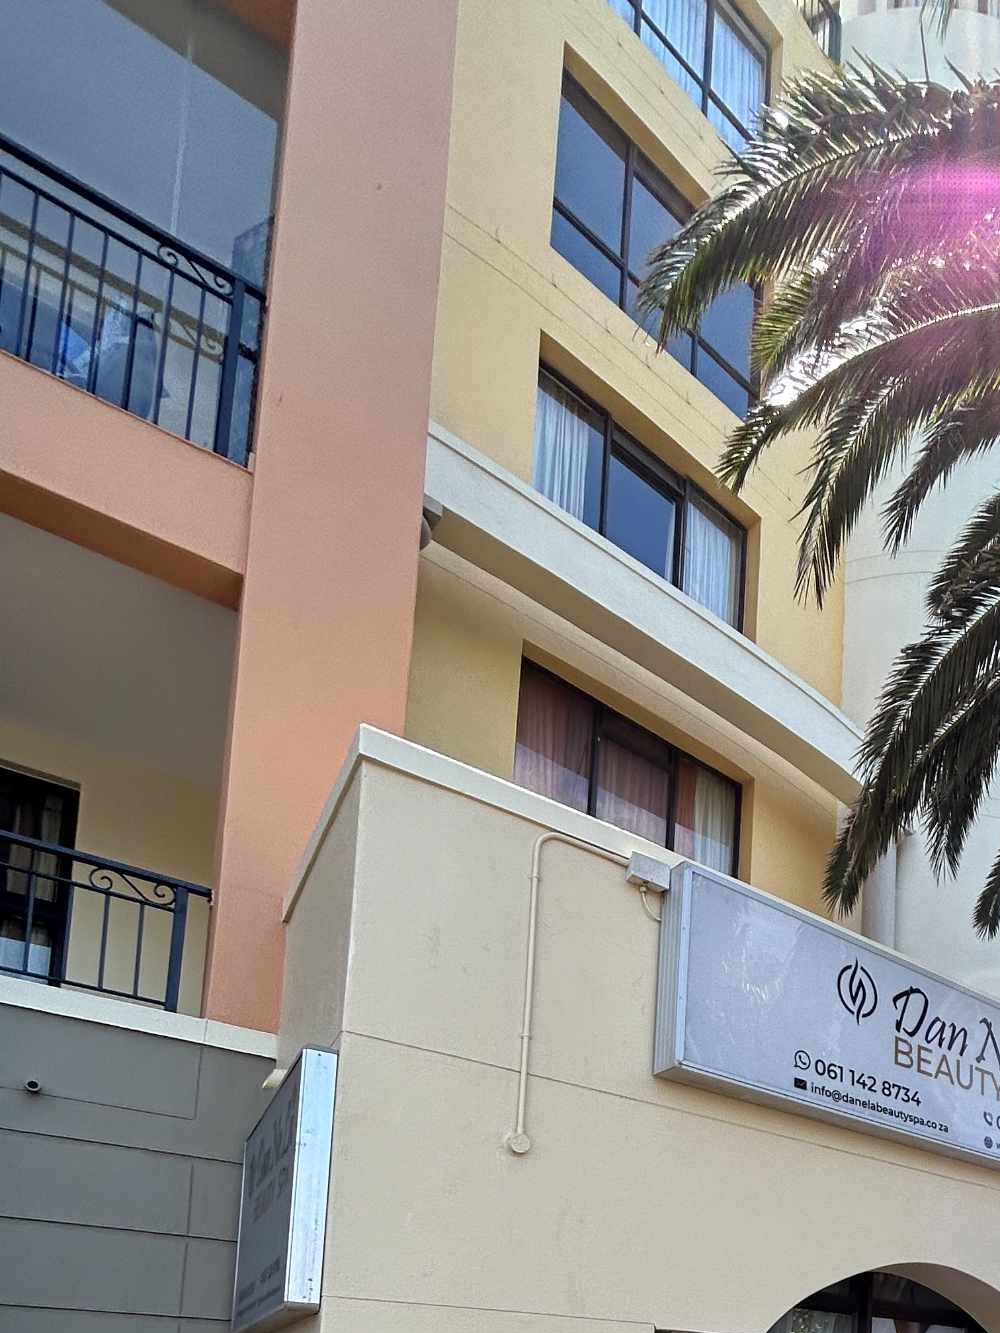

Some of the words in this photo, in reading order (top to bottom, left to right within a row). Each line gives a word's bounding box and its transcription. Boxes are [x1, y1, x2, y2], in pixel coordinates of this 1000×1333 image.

[893, 986, 968, 1057] Dan
[811, 1082, 949, 1133] info@danelabeautyspa.coza
[815, 1059, 844, 1083] 061
[849, 1069, 878, 1093] 142
[881, 1080, 922, 1108] 8734
